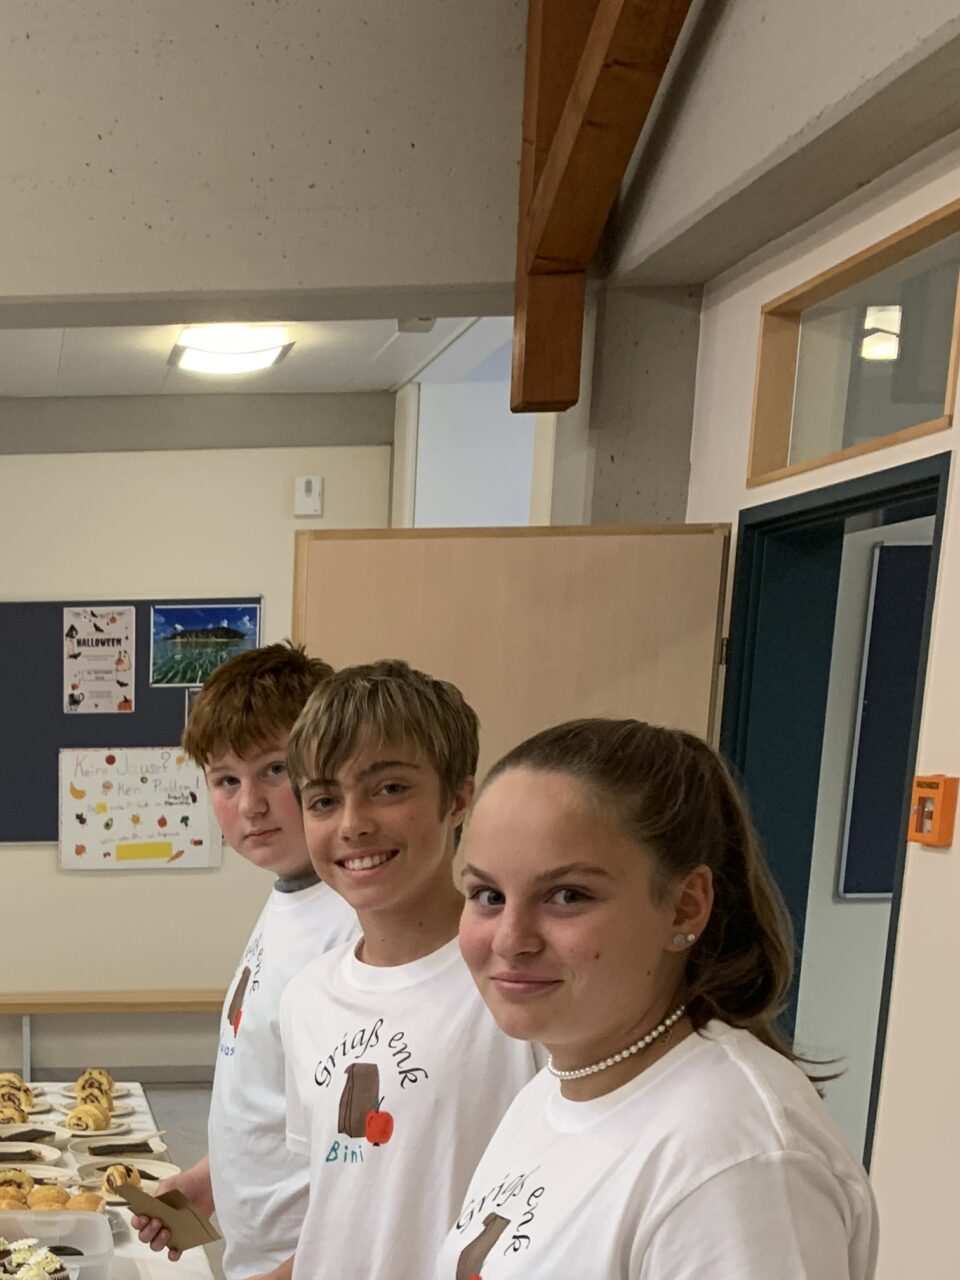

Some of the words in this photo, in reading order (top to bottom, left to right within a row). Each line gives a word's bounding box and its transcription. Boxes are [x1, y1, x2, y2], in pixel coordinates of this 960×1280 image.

[76, 638, 122, 648] HALLOWEEN
[314, 1018, 384, 1088] Griaß
[388, 1031, 429, 1089] enk
[325, 1140, 365, 1164] Bini
[503, 1186, 545, 1257] enk
